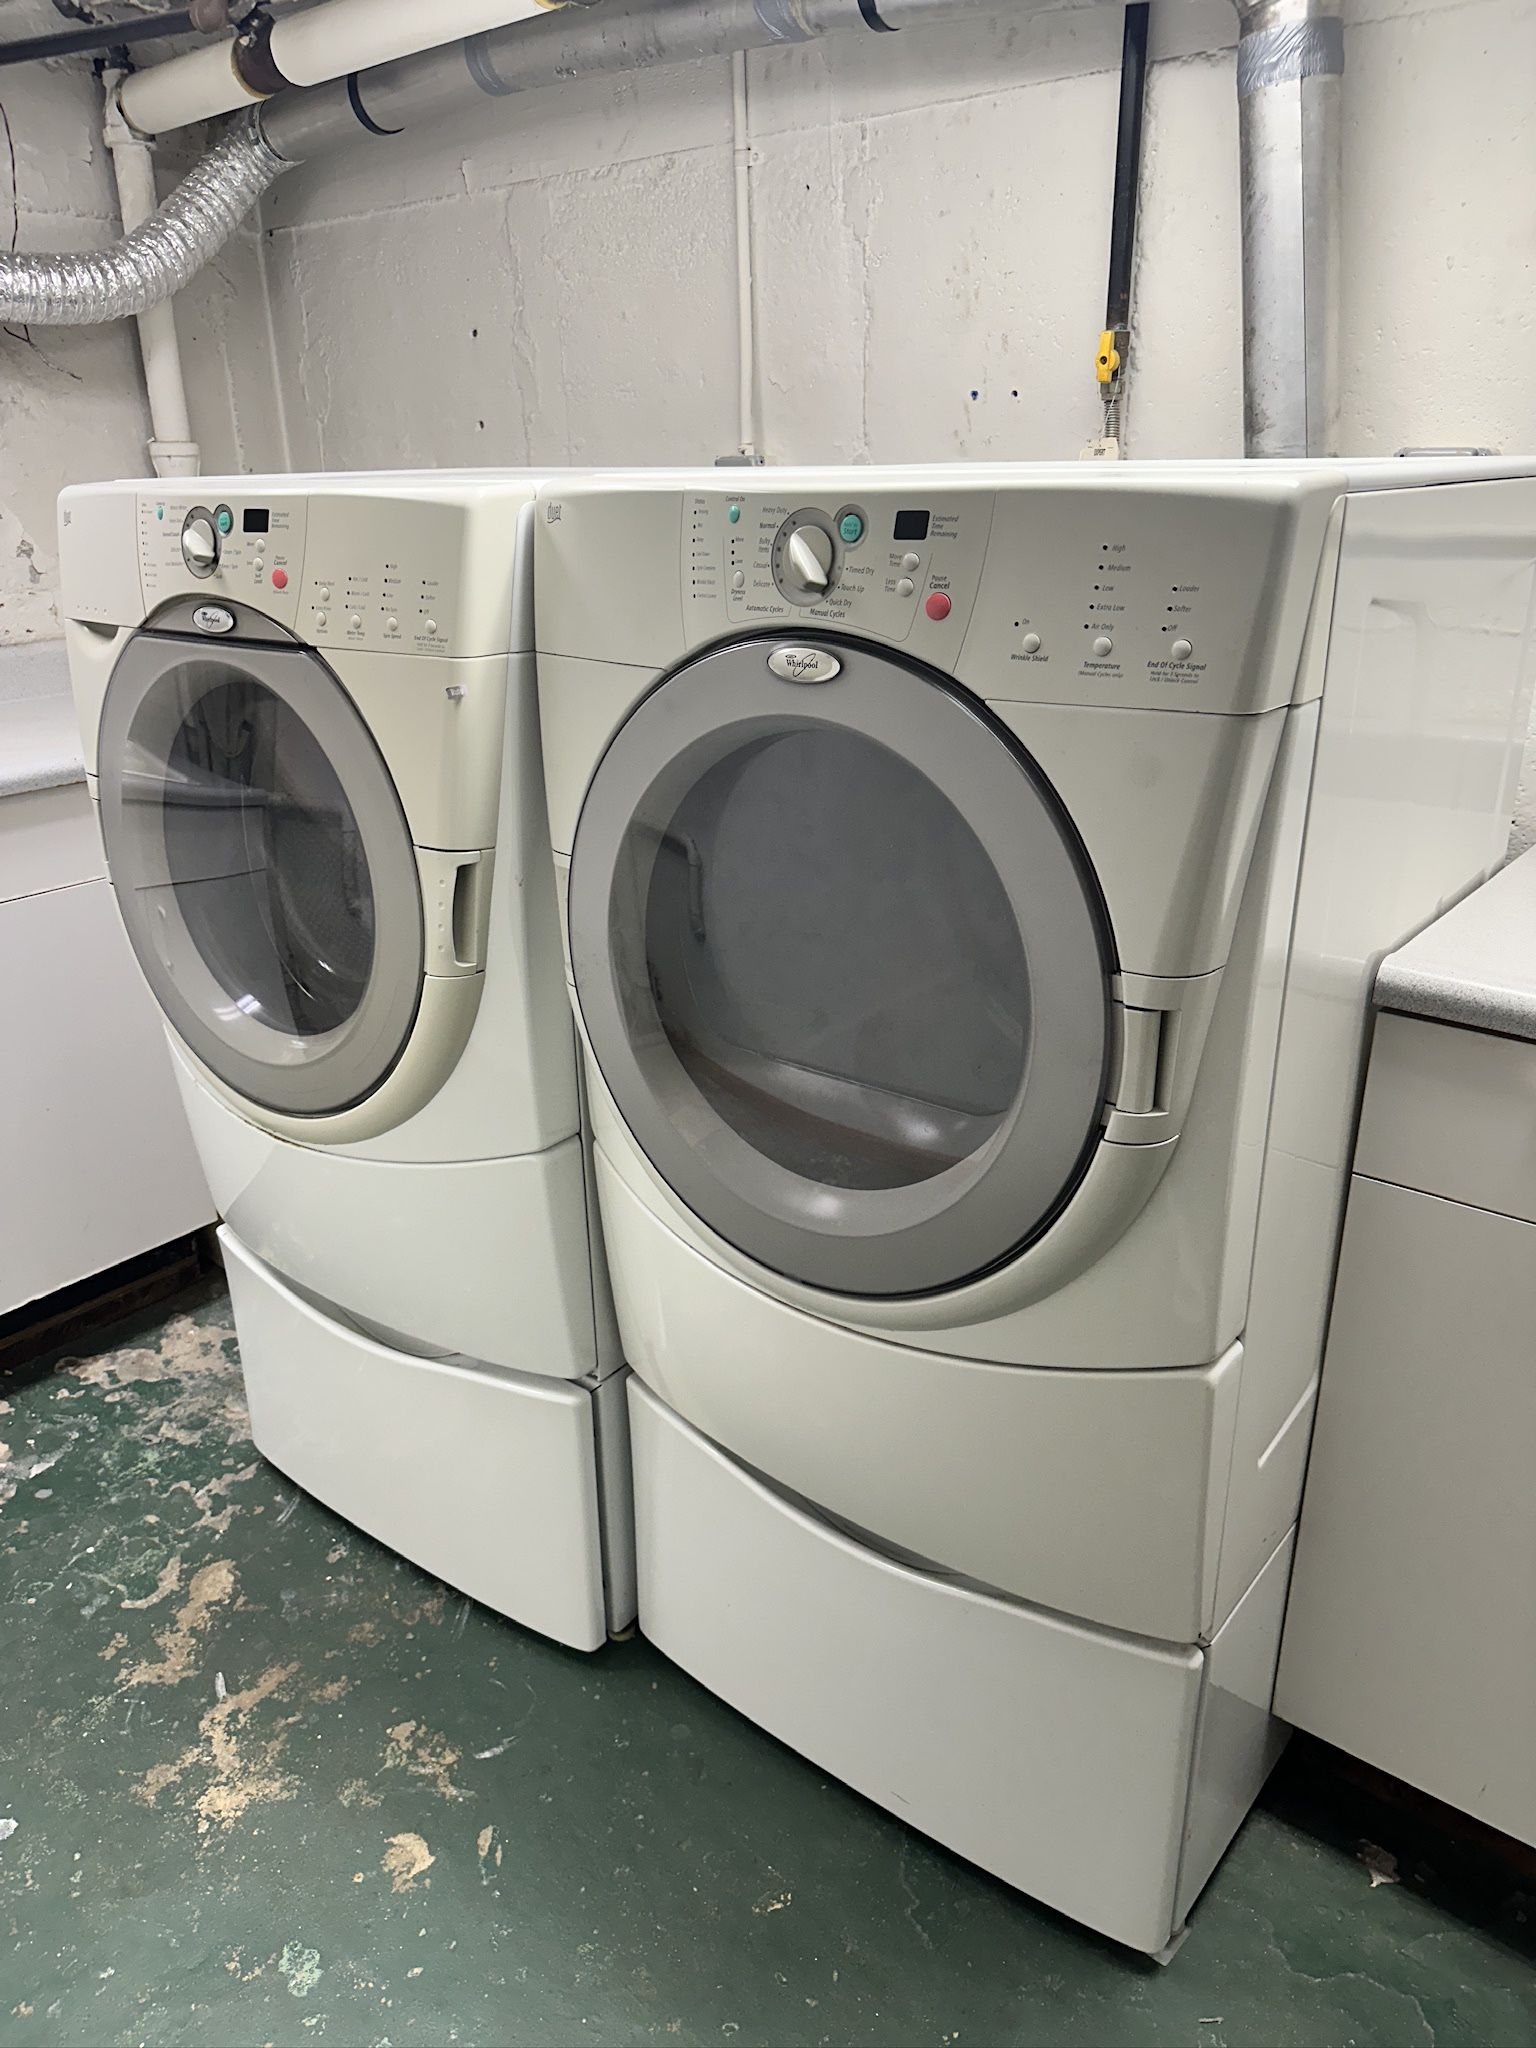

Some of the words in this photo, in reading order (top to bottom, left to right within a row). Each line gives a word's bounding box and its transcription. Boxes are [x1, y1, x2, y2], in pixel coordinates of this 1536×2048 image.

[843, 527, 858, 535] Start
[930, 530, 958, 539] Remaining
[1112, 544, 1126, 553] High
[849, 566, 865, 574] Timed
[865, 567, 875, 576] Dry
[857, 585, 865, 593] Up
[1179, 585, 1200, 593] Louder
[829, 599, 843, 607] Quick
[844, 600, 853, 608] Dry
[1096, 603, 1113, 611] Extra
[1113, 604, 1125, 612] Low
[746, 604, 769, 612] Automatic
[770, 606, 784, 614] Cycles
[809, 608, 829, 616] Manual
[830, 610, 846, 618] Cycles
[1173, 605, 1192, 613] Softer
[1091, 623, 1100, 631] Air
[1101, 624, 1114, 632] Only
[1010, 654, 1031, 662] Wrinkle
[1032, 655, 1049, 663] Shield
[1083, 661, 1121, 670] Temperature
[1147, 660, 1160, 668] End
[1160, 661, 1168, 669] Of
[1168, 661, 1185, 670] Cycle
[1186, 663, 1207, 672] Signal
